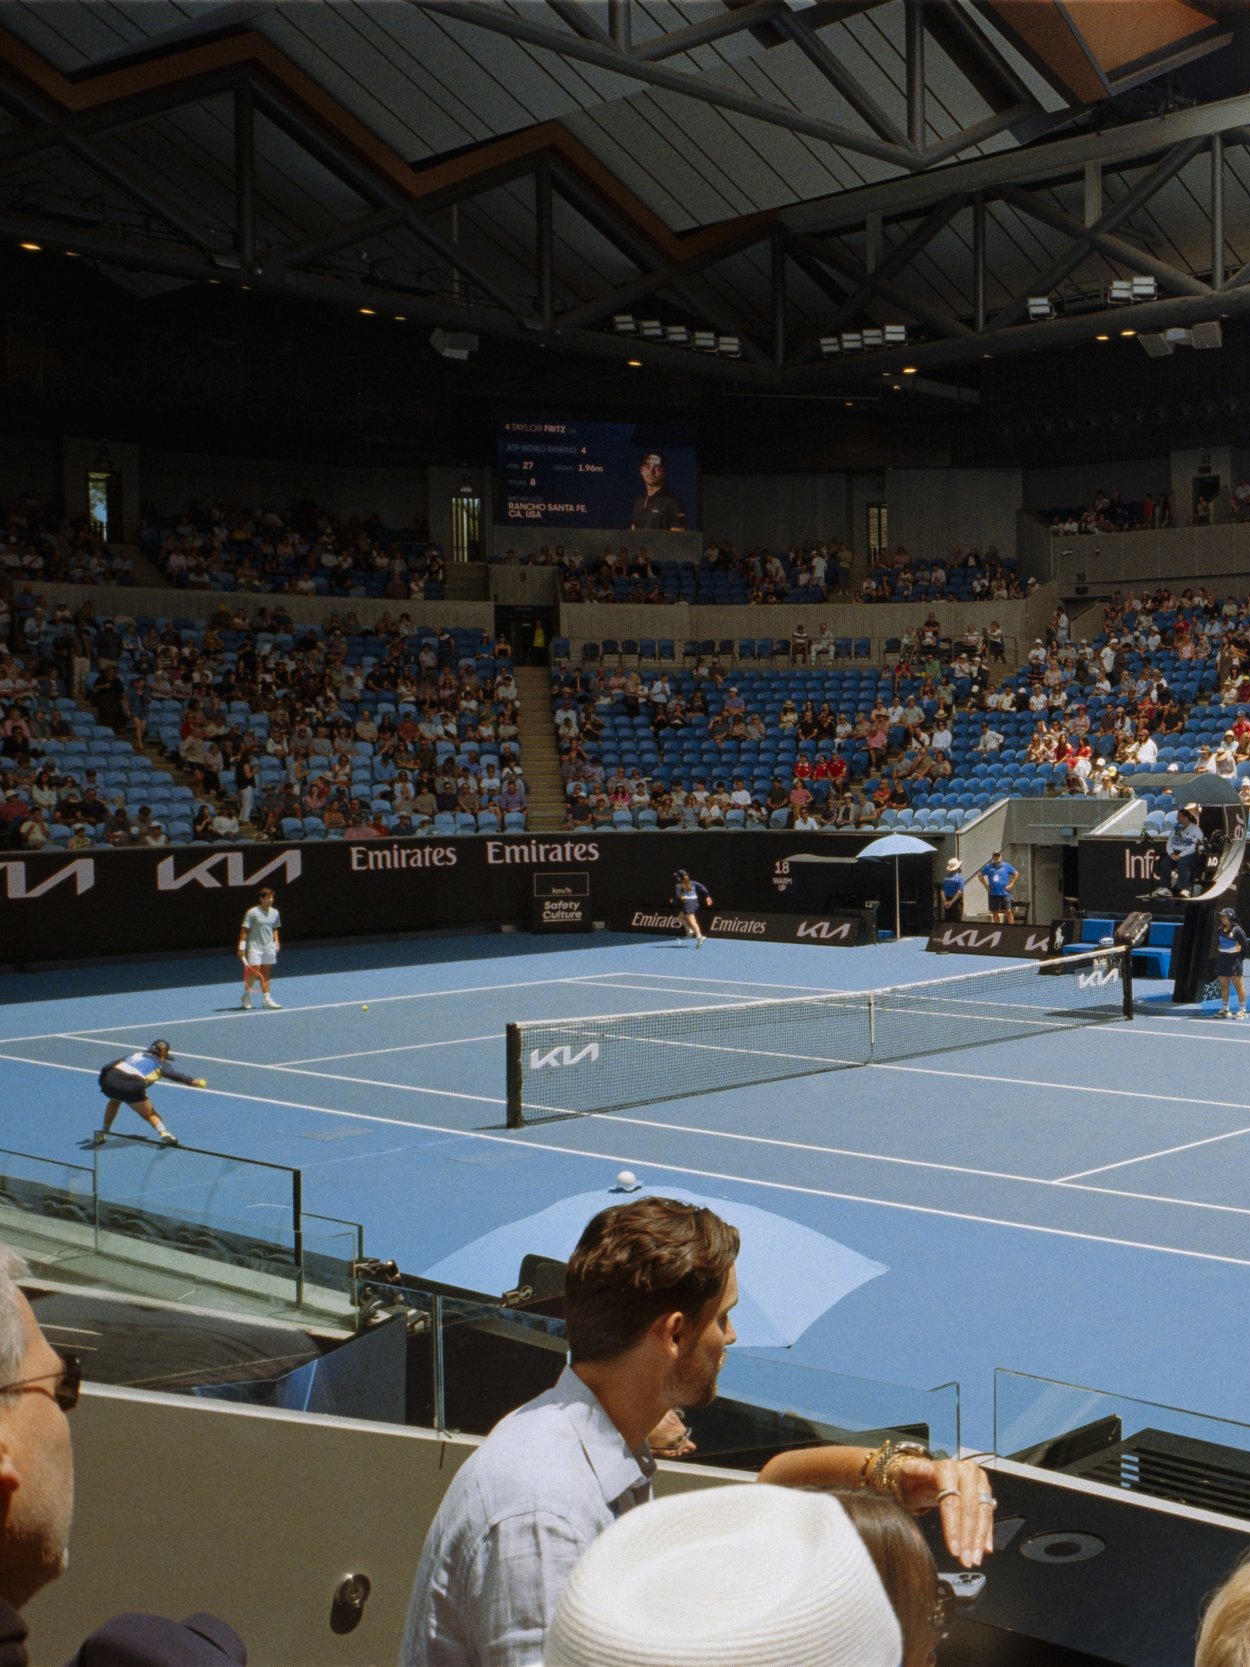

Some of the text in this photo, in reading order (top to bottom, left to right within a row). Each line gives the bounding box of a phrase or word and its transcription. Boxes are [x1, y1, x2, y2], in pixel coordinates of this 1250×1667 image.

[512, 423, 542, 432] TAYLOR
[543, 424, 566, 434] FRITZ
[522, 461, 535, 470] 27
[578, 463, 603, 473] 1.96m
[507, 502, 546, 511] RANCHO
[547, 503, 575, 513] SANTA
[525, 510, 542, 519] USA
[350, 844, 458, 871] Emirates
[486, 839, 600, 864] Emirates
[157, 850, 302, 891] KIA
[774, 860, 791, 875] 18
[772, 876, 793, 886] WARM
[551, 887, 573, 895] km/h
[544, 900, 581, 911] Safety
[542, 910, 582, 920] Culture
[631, 912, 683, 930] Emirates
[710, 916, 767, 934] Emirates
[797, 920, 851, 940] KIA
[942, 928, 1002, 949] KIA
[1078, 967, 1119, 989] KIA
[530, 1043, 599, 1070] KIA
